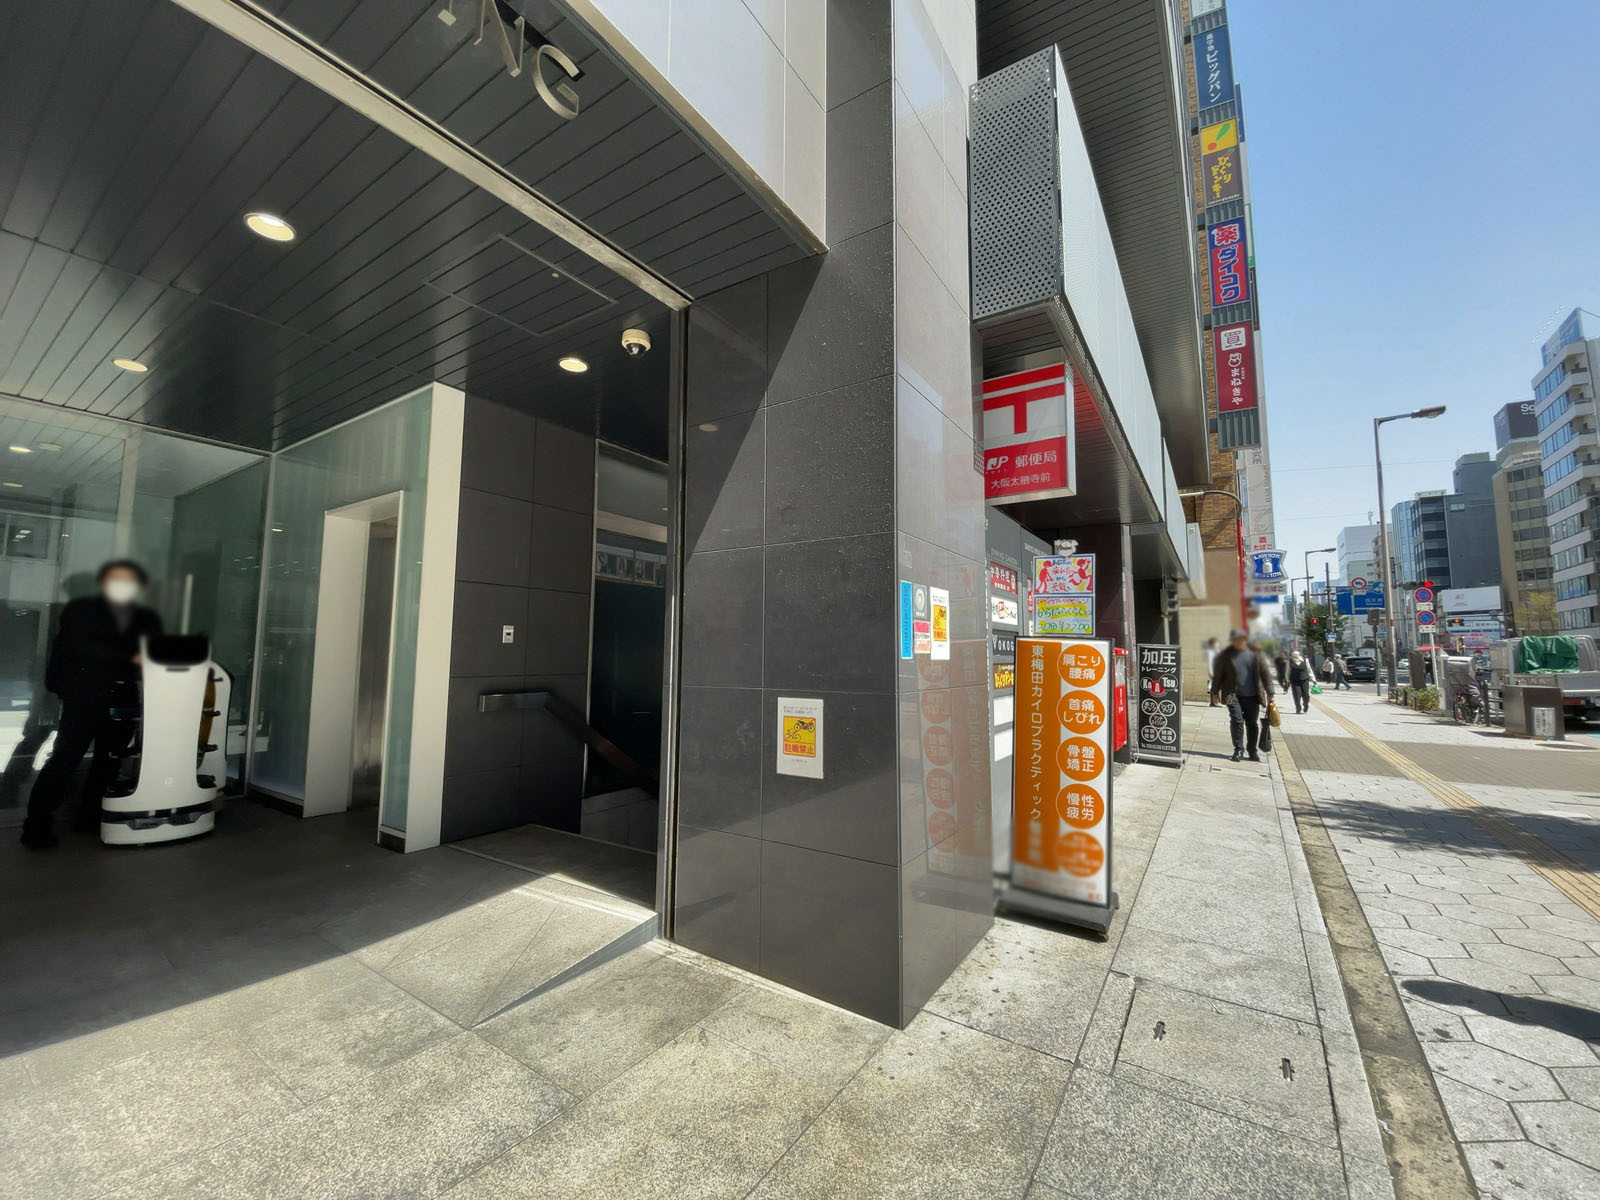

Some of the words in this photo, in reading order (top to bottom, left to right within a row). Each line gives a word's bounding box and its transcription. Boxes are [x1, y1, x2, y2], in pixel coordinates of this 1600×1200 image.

[1214, 224, 1240, 246] 薬
[1218, 245, 1240, 303] ダイコク
[1224, 331, 1242, 348] 買
[1231, 368, 1243, 405] まねきや
[1015, 450, 1057, 469] 郵便局
[991, 472, 1051, 489] 大阪太融寺前
[1063, 654, 1101, 667] 肩こり
[1142, 649, 1176, 666] 加圧
[1069, 667, 1096, 680] 腰痛
[1068, 698, 1095, 712] 首痛
[1063, 712, 1102, 725] しびれ
[1067, 745, 1096, 759] 骨盤
[1066, 758, 1095, 773] 矯正
[1066, 792, 1095, 808] 慢性
[1066, 806, 1095, 821] 疲労
